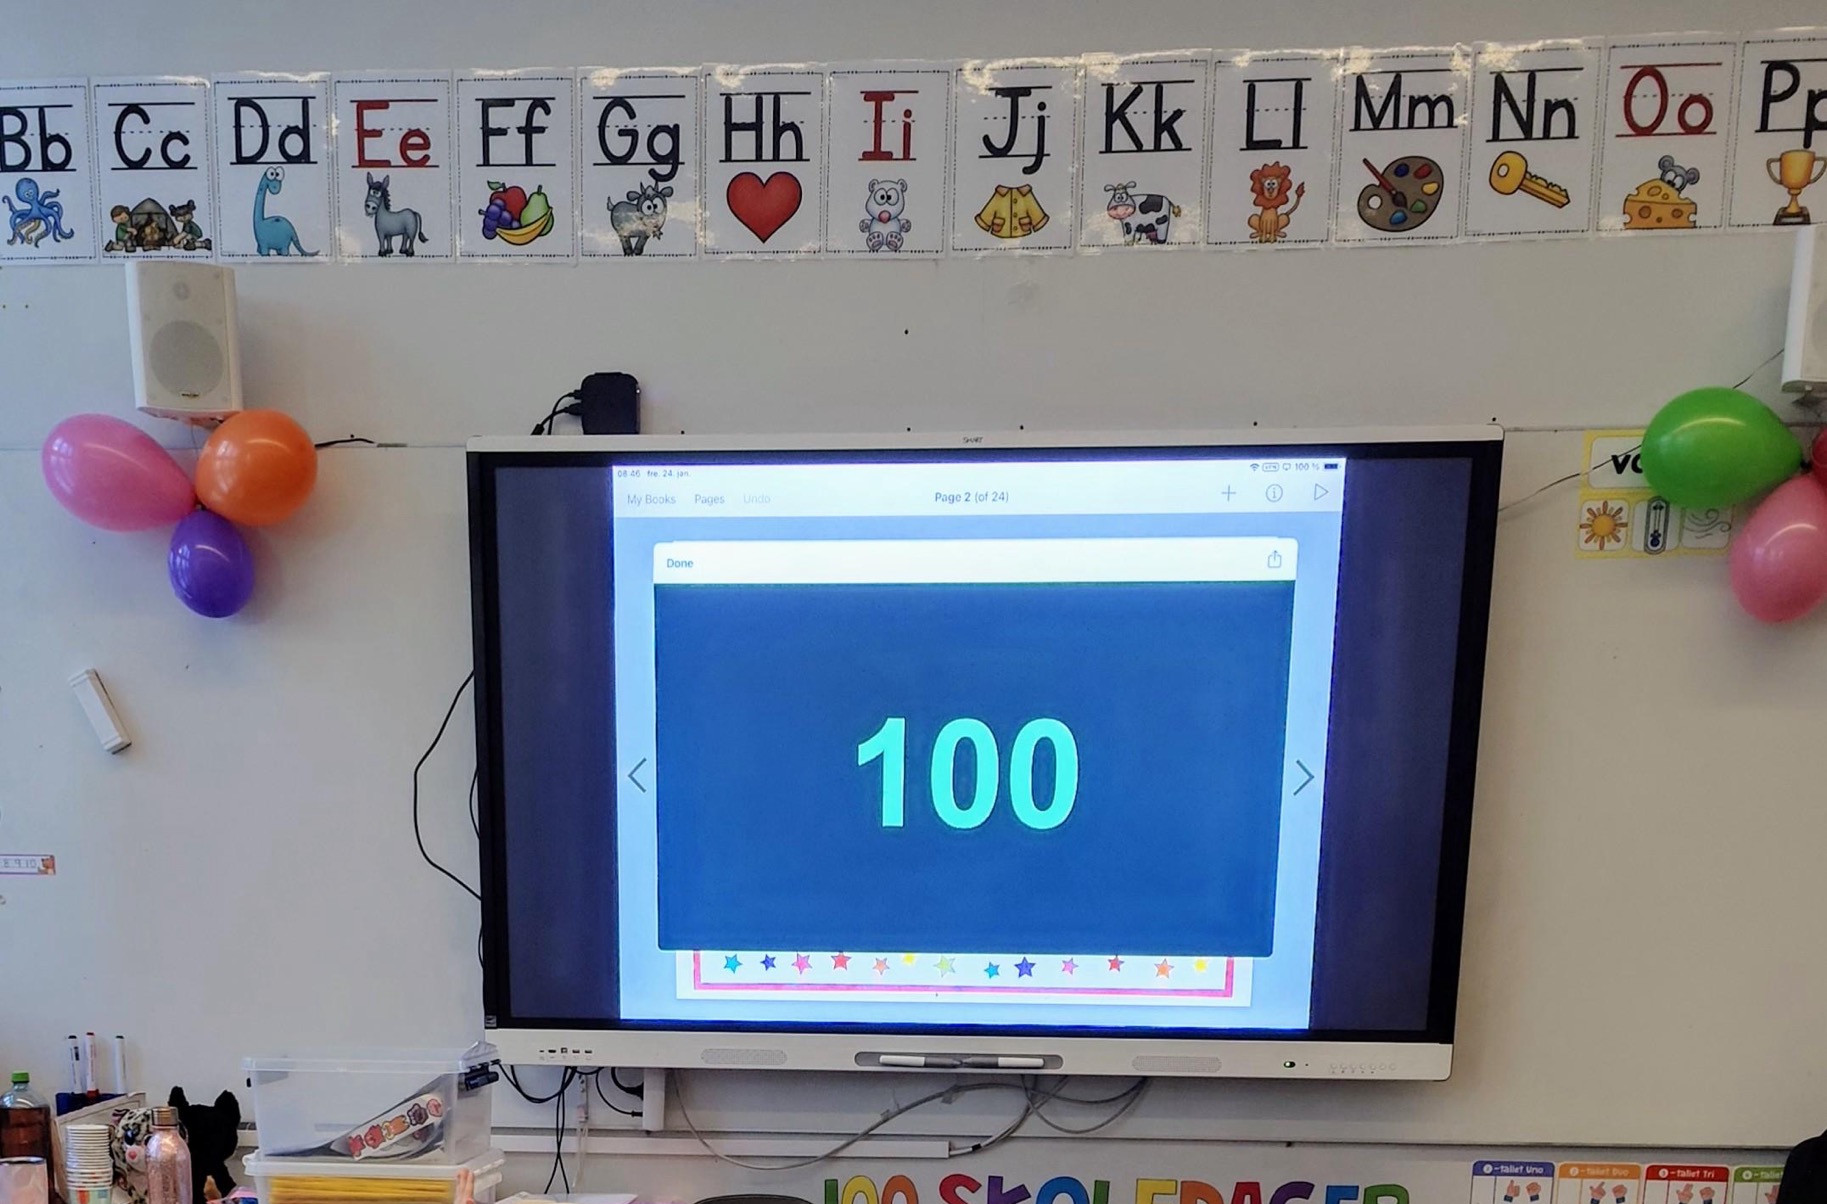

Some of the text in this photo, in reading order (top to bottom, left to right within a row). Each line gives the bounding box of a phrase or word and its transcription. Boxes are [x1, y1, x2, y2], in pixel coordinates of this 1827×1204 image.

[234, 98, 311, 163] Dd
[356, 100, 430, 167] Ee
[482, 98, 552, 166] Ff
[724, 93, 803, 161] Hh
[862, 91, 912, 160] Ii
[982, 88, 1051, 175] Jj
[1105, 84, 1184, 152] Kk
[1354, 72, 1455, 130] Mm
[1493, 71, 1577, 140] Nn
[1624, 66, 1713, 136] Oo
[0, 106, 72, 171] Bb
[115, 104, 191, 168] Cc
[598, 97, 681, 182] Gg
[627, 495, 676, 505] My Books
[695, 495, 725, 505] Pages
[743, 494, 771, 504] Undo
[935, 491, 1009, 504] Page 2 (of 24)
[667, 558, 693, 568] Done
[858, 718, 1079, 829] 100
